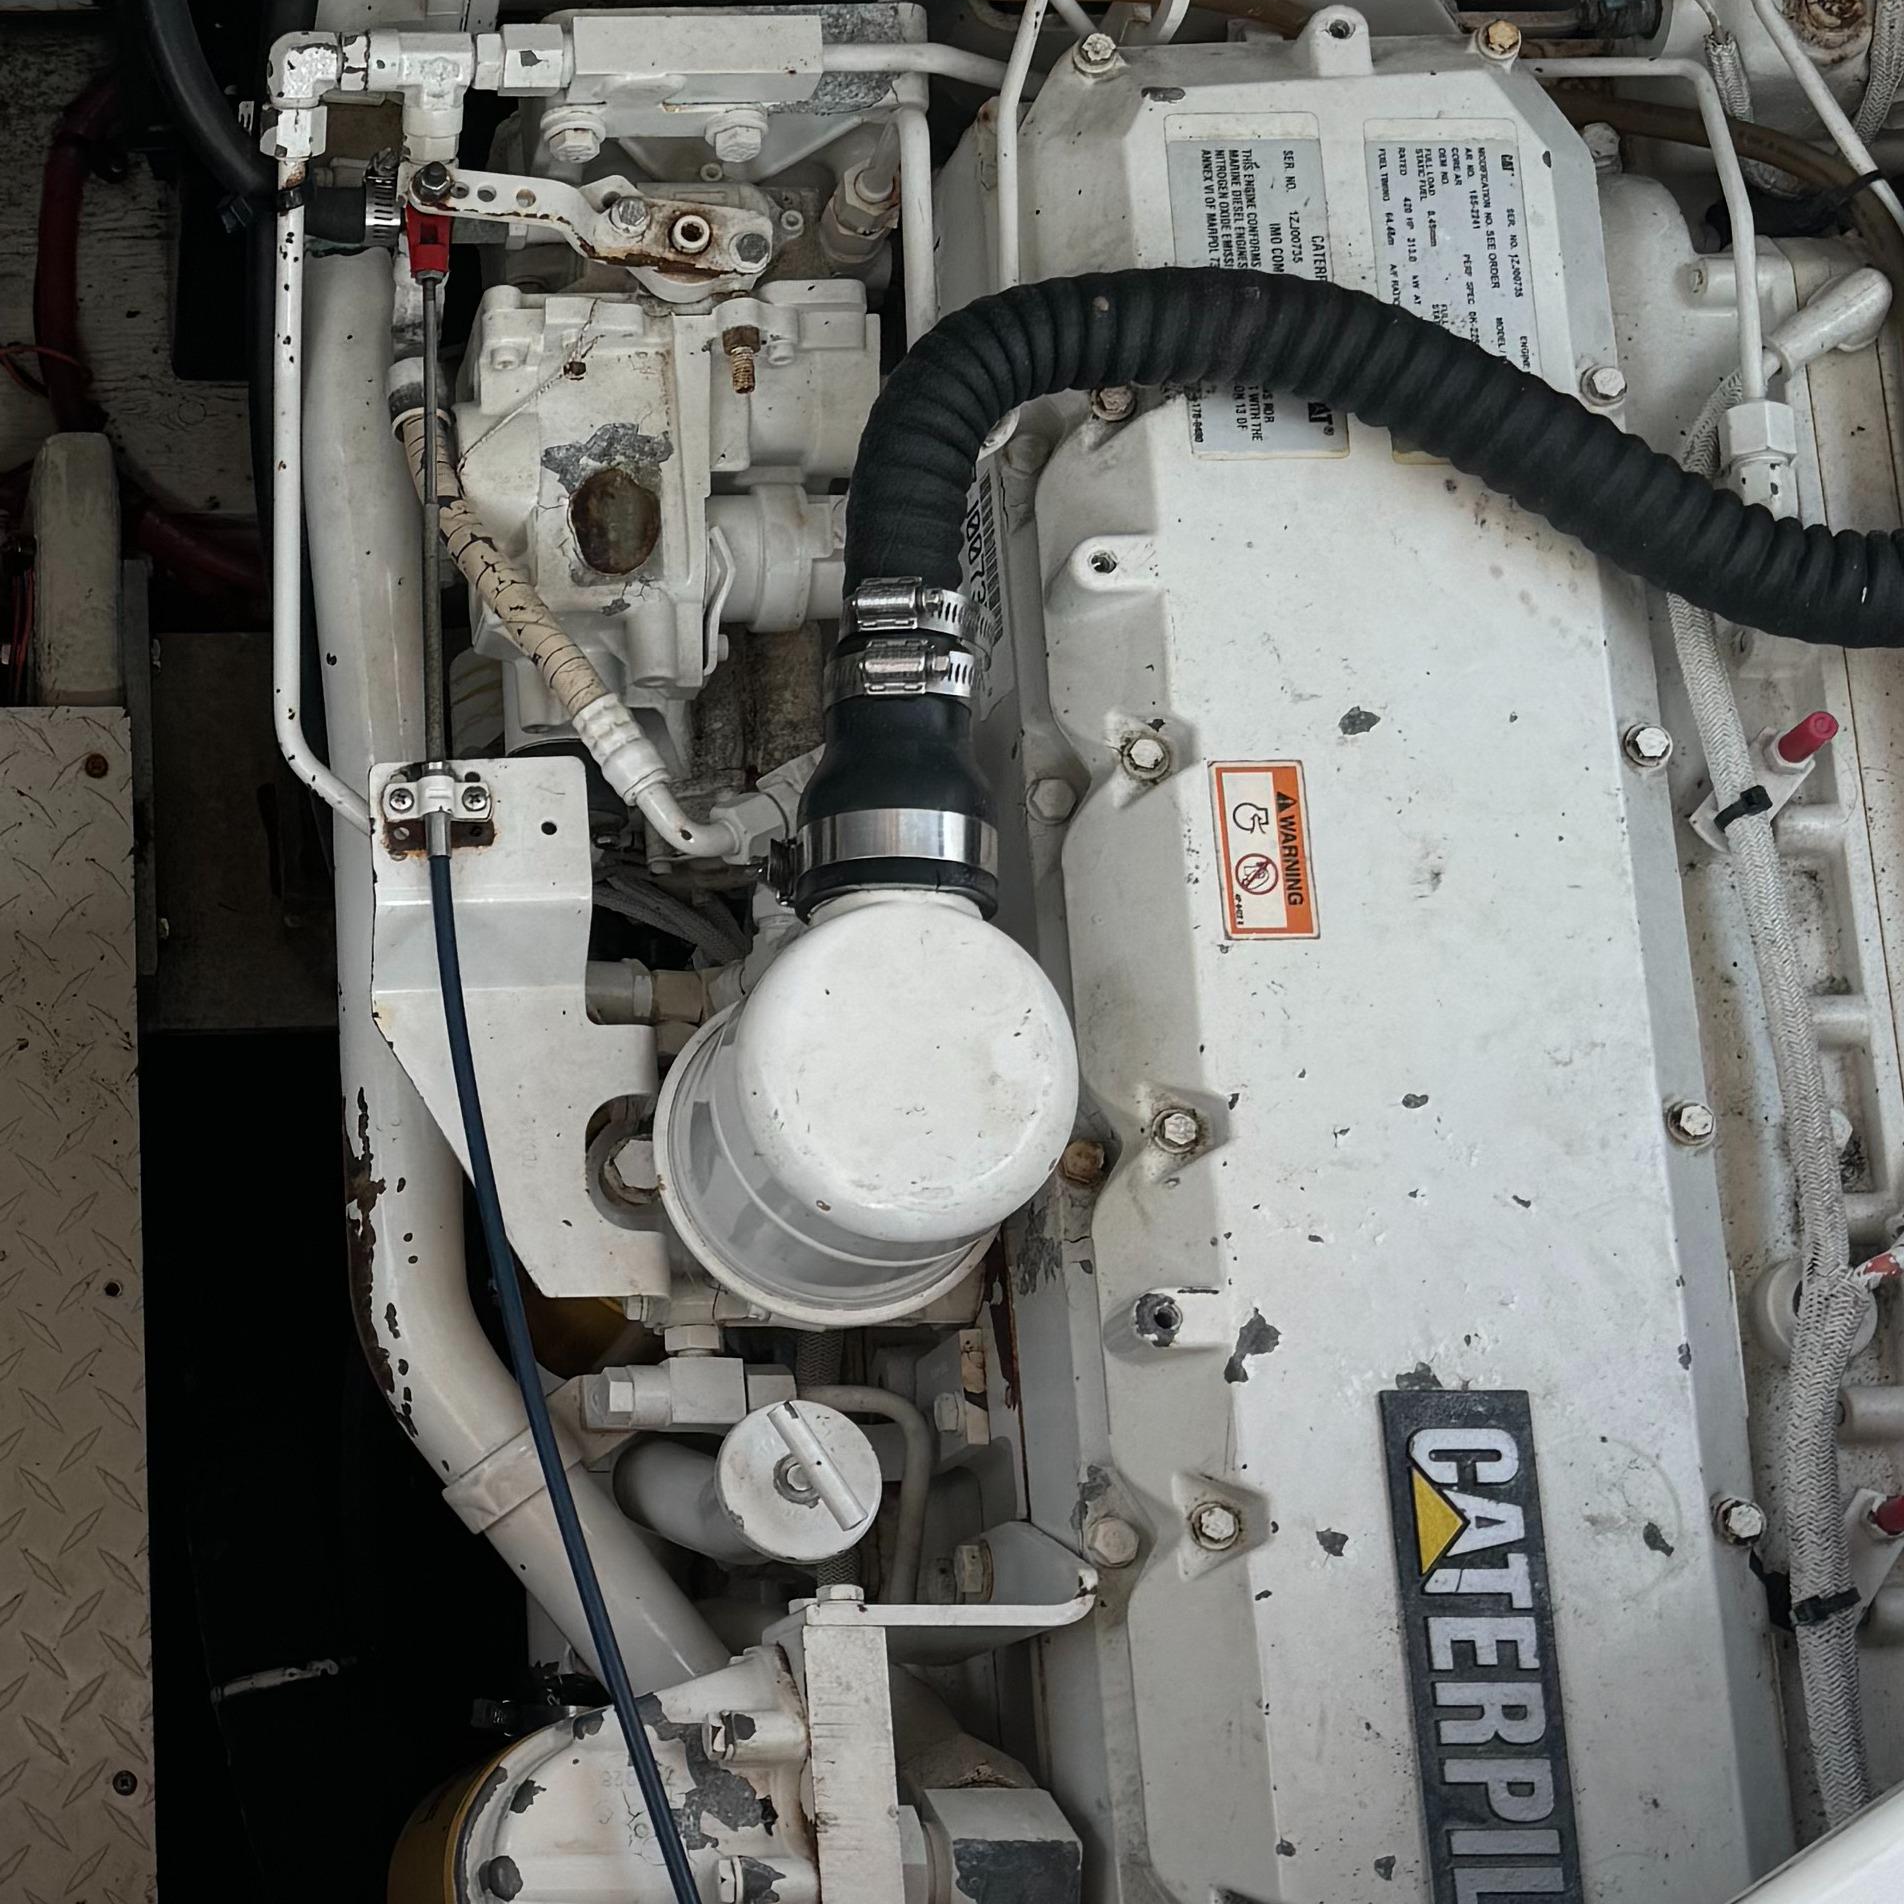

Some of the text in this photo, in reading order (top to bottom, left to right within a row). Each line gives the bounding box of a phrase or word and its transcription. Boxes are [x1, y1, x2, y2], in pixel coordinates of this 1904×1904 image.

[1229, 149, 1242, 186] MARINE
[1378, 149, 1387, 169] FUEL
[1398, 147, 1407, 175] RATED
[1416, 149, 1425, 177] STATIC
[1465, 148, 1473, 160] AR
[1501, 155, 1514, 171] CAT
[1215, 149, 1228, 199] NITROGEN
[1285, 176, 1296, 192] NO.
[1478, 147, 1490, 208] MODIFICATION
[1201, 149, 1219, 253] ANNEX VI OF MARPOL
[1232, 190, 1244, 223] DIESEL
[1242, 149, 1261, 268] THIS ENGINE CONFORMS
[1219, 202, 1231, 230] OXIDE
[1235, 227, 1248, 268] ENGINES
[1270, 223, 1283, 244] IMO
[1486, 231, 1496, 250] SEE
[1488, 253, 1500, 288] ORDER
[1496, 318, 1506, 348] MODEL
[1249, 394, 1260, 419] WITH
[1308, 403, 1333, 425] AT
[1251, 423, 1262, 441] THE
[1280, 816, 1303, 905] WARNING
